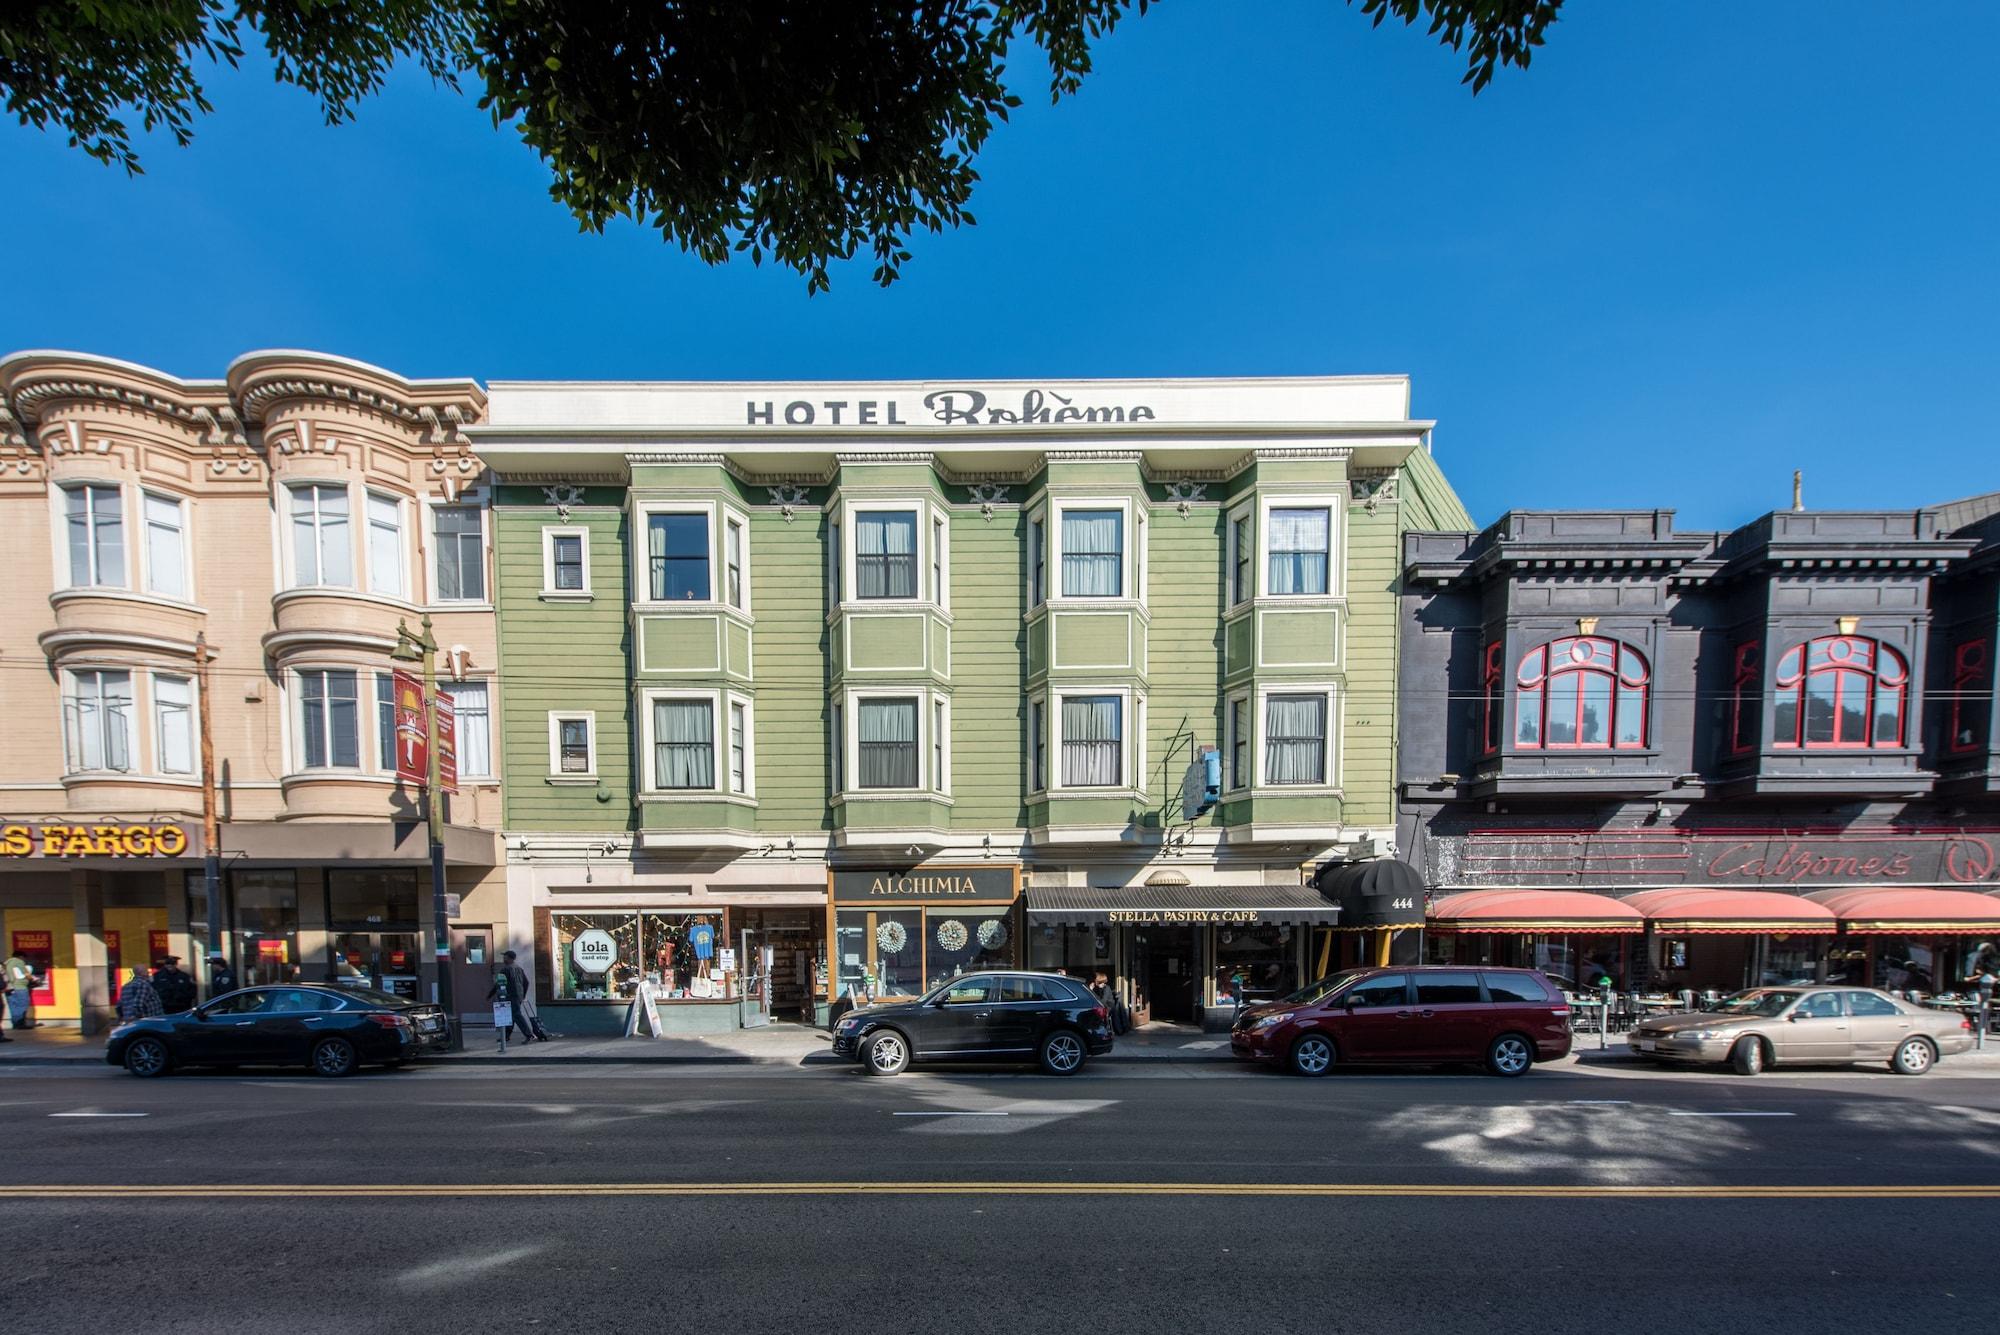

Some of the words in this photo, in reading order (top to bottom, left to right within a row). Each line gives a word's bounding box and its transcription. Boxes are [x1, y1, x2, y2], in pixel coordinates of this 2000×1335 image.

[747, 400, 907, 425] HOTEL
[40, 825, 189, 857] FARGO
[871, 877, 977, 895] ALCHIMIA
[1392, 898, 1413, 909] 444
[1109, 911, 1160, 922] STELLA
[1163, 911, 1211, 922] PASTRY
[1210, 911, 1220, 921] &
[1222, 911, 1258, 921] CAFE
[581, 941, 609, 952] lola
